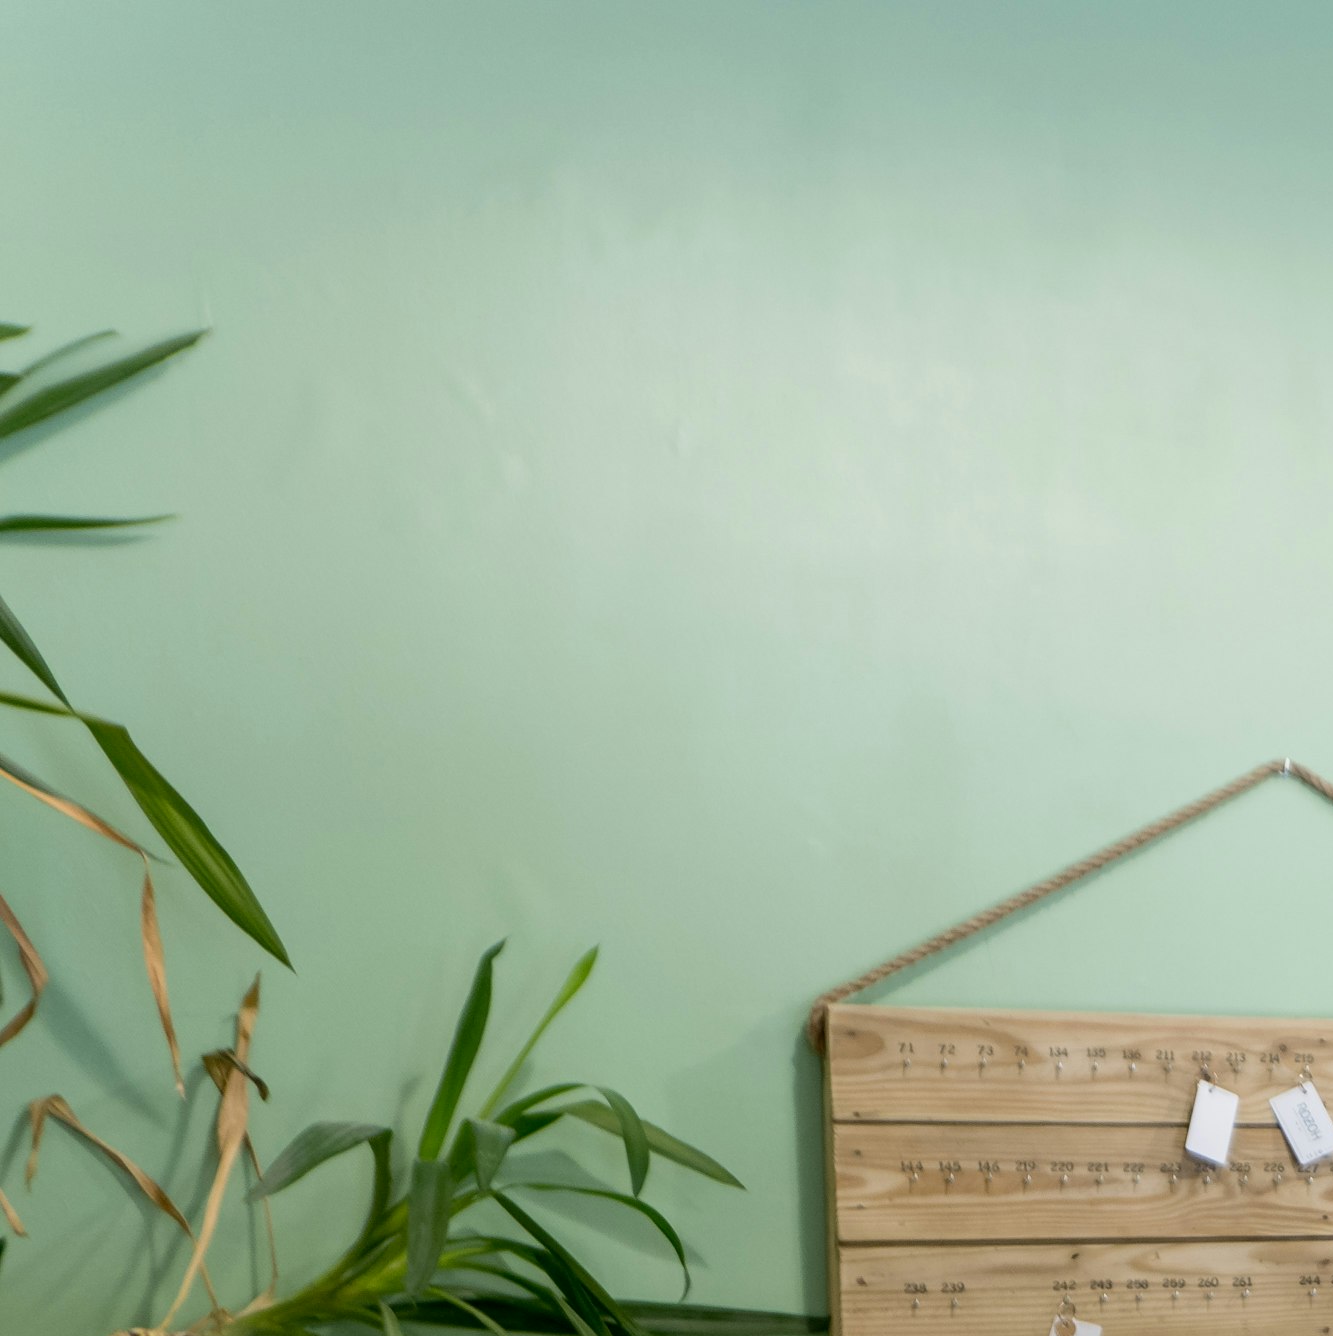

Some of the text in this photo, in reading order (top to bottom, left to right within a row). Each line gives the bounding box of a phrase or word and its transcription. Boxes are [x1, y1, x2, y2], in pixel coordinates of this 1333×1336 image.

[899, 1042, 914, 1055] 71
[938, 1043, 955, 1056] 72
[977, 1044, 994, 1056] 73
[1049, 1046, 1068, 1057] 134
[1156, 1049, 1174, 1061] 211
[1259, 1052, 1280, 1064] 214
[900, 1160, 923, 1172] 144
[1015, 1161, 1036, 1171] 219
[1050, 1161, 1074, 1172] 220
[1087, 1161, 1108, 1172] 221
[1263, 1162, 1284, 1173] 226
[940, 1281, 965, 1294] 239
[1052, 1280, 1076, 1292] 242
[1090, 1278, 1112, 1290] 243
[1197, 1277, 1219, 1288] 260
[1232, 1276, 1253, 1287] 261
[1299, 1275, 1320, 1286] 244
